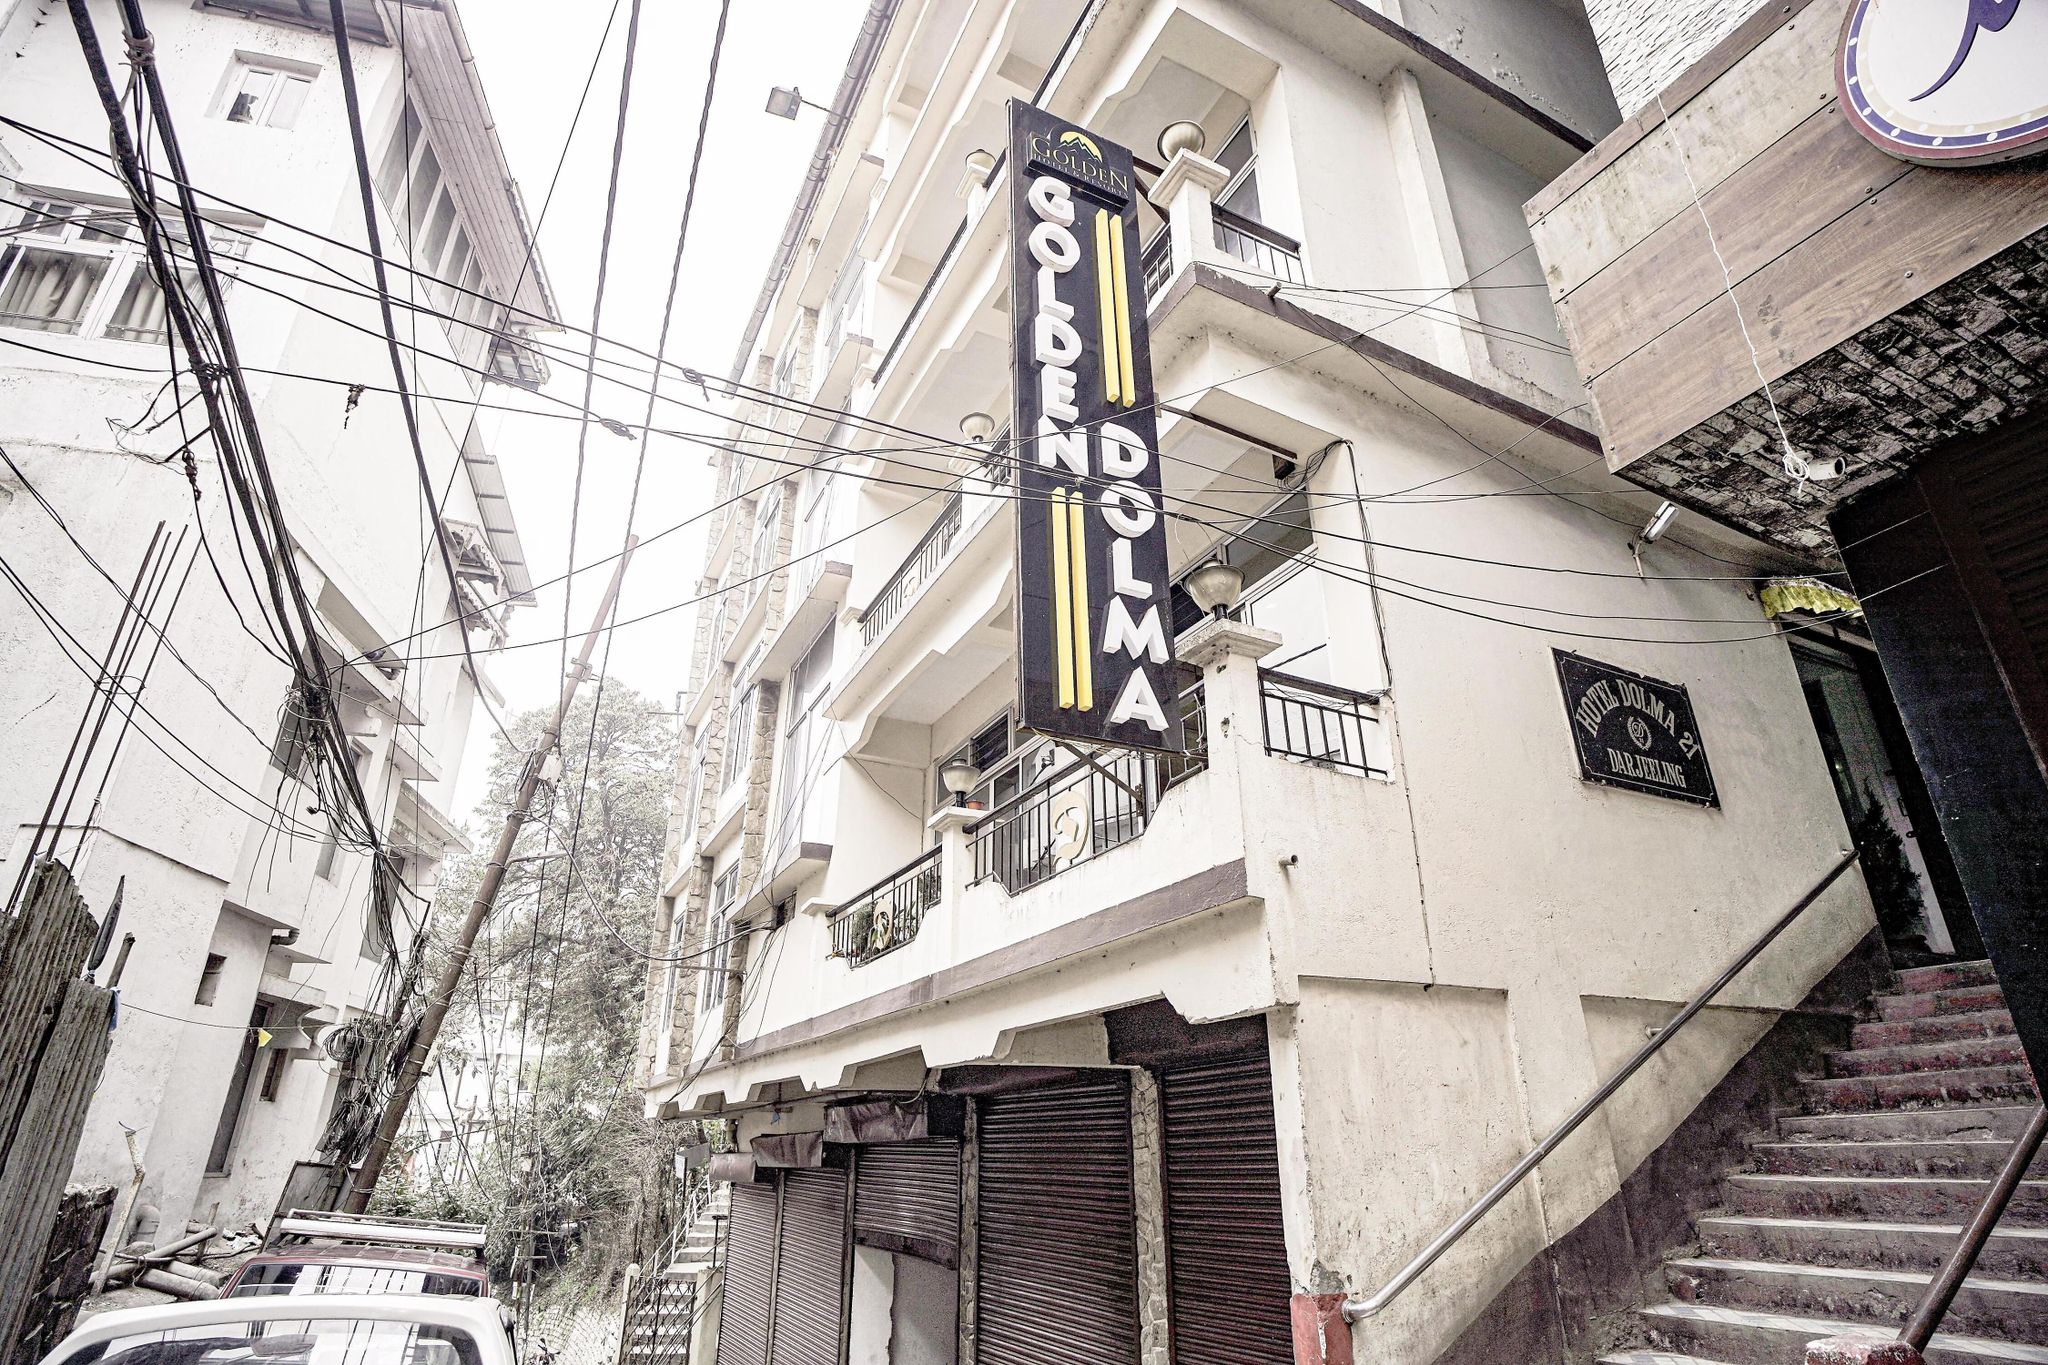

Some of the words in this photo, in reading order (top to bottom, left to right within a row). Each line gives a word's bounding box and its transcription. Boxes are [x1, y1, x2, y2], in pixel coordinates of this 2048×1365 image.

[1032, 137, 1128, 192] GOLDEN
[1028, 176, 1089, 477] GOLDEN
[1100, 421, 1170, 732] DOLMA
[1576, 680, 1619, 738] HOTEL
[1616, 679, 1675, 736] DOLMA
[1607, 747, 1687, 788] DARJEELING
